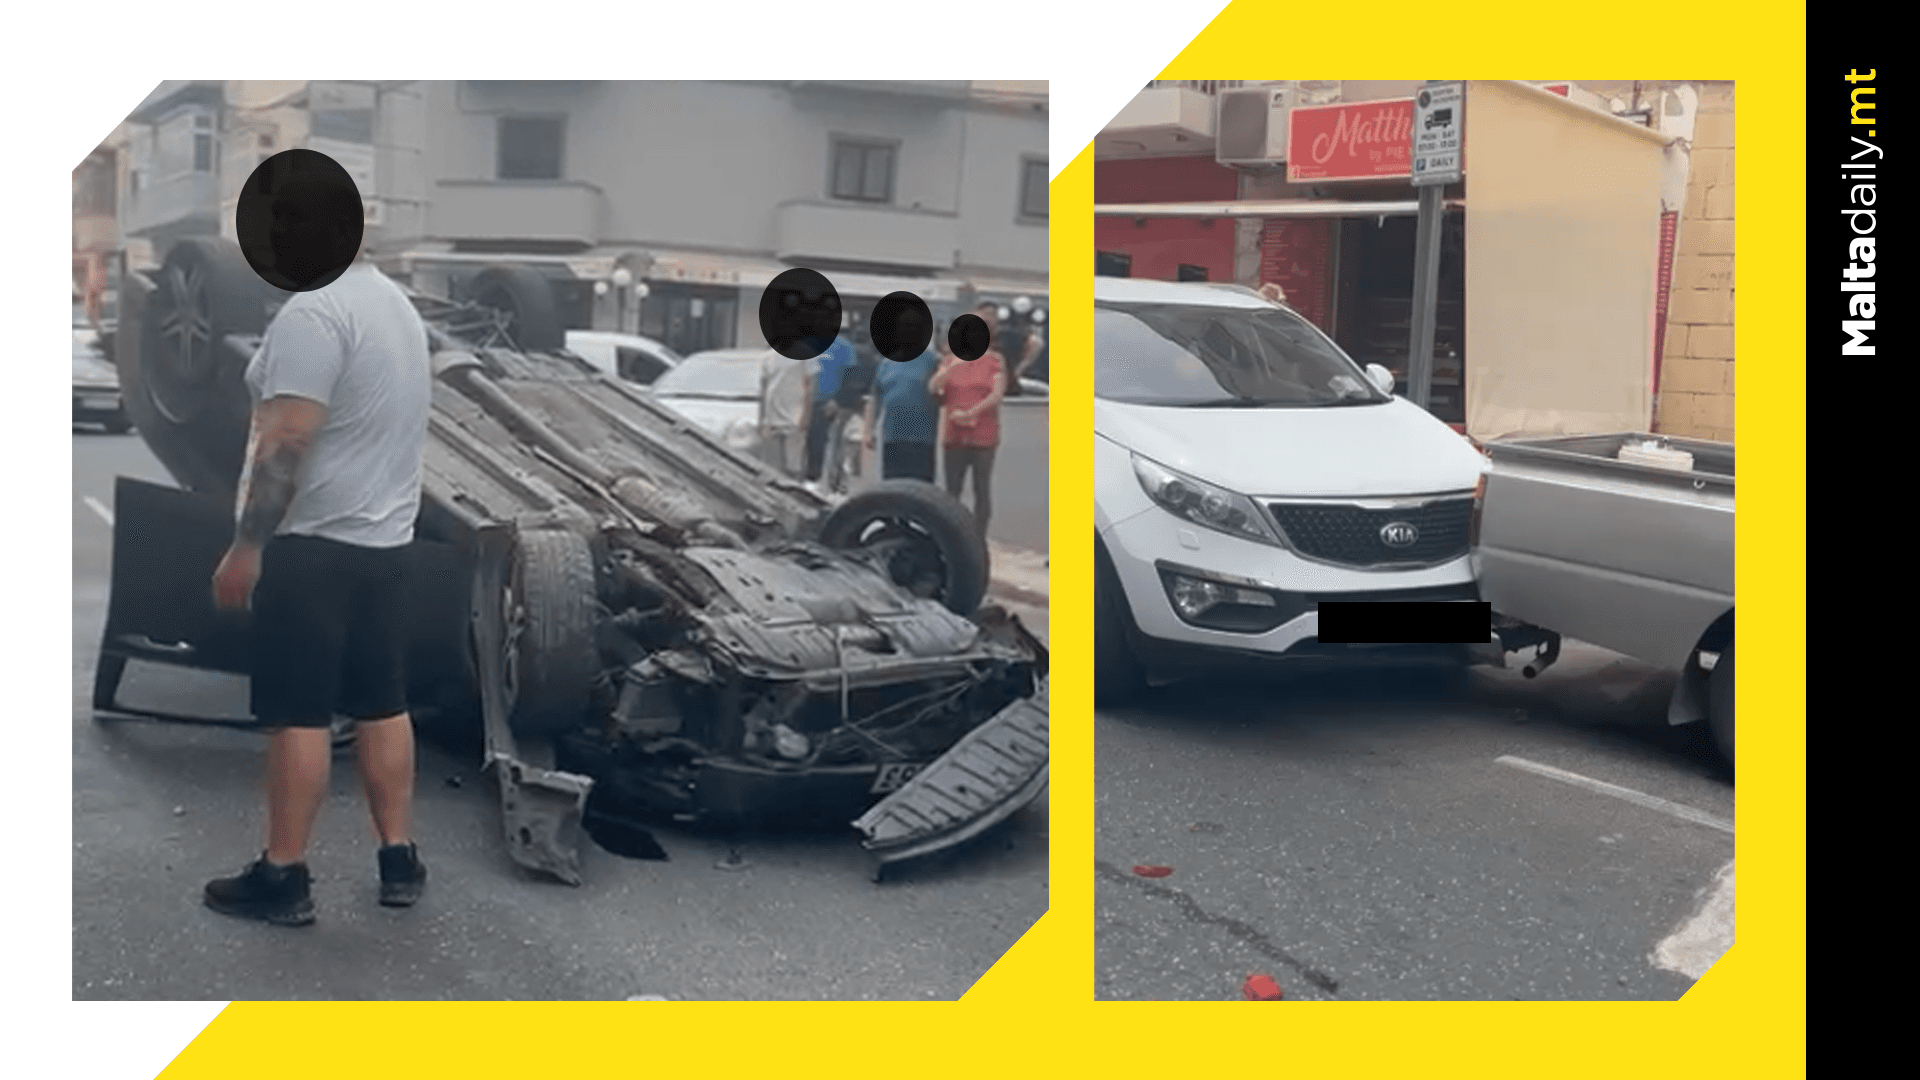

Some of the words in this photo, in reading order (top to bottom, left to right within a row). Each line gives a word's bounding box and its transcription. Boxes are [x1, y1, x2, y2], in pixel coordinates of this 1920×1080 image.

[1312, 107, 1414, 164] Matth
[1431, 157, 1454, 168] DAILY
[1387, 527, 1414, 544] KIA
